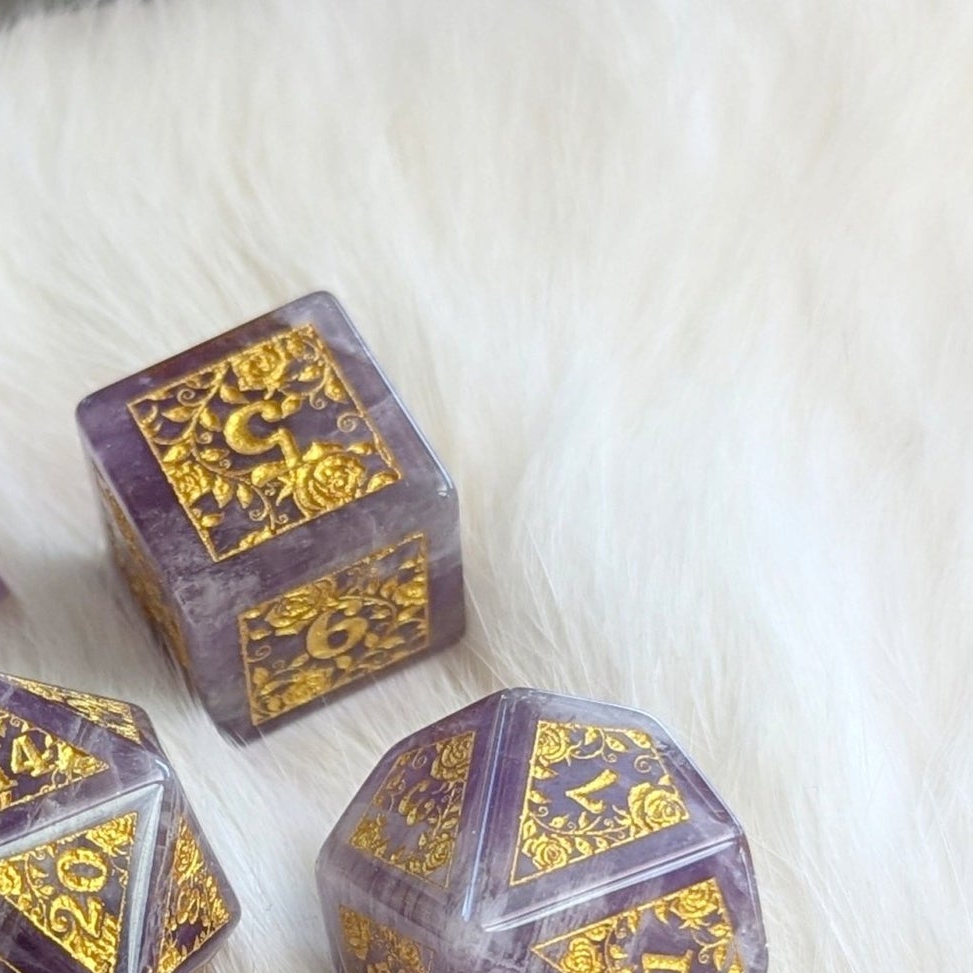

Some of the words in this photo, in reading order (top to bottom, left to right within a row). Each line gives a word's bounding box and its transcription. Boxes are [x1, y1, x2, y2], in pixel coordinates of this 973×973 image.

[224, 400, 300, 487] 5
[306, 599, 369, 660] 6
[565, 769, 619, 815] 7
[50, 848, 108, 938] 20
